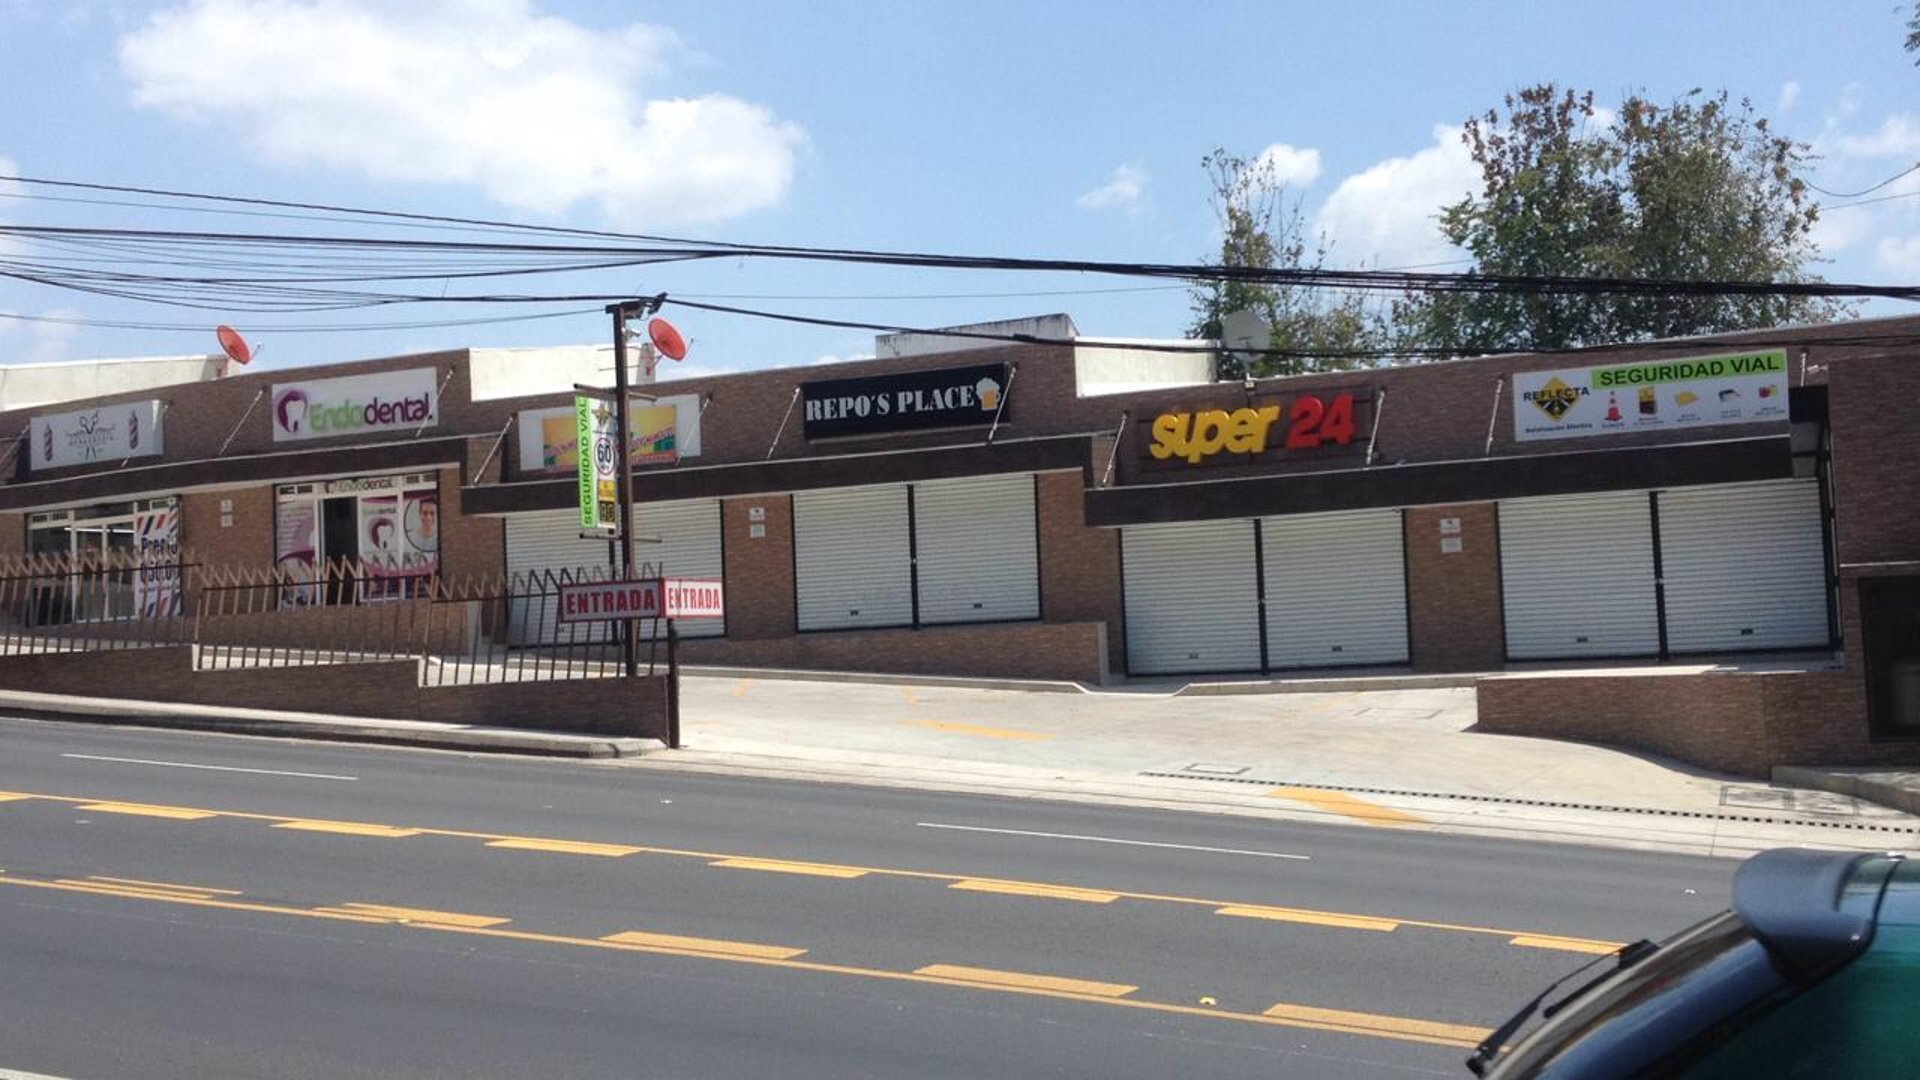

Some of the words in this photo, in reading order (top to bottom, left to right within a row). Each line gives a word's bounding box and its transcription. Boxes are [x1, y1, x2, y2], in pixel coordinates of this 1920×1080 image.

[1600, 361, 1724, 386] SEGURIDAD
[1730, 356, 1779, 373] VIAL
[310, 392, 432, 432] Endodental
[579, 395, 590, 432] VIAL
[897, 385, 974, 413] PLACE
[1150, 404, 1280, 464] super
[1287, 393, 1356, 449] 24
[581, 437, 593, 525] SEGURIDAD
[566, 589, 655, 615] ENTRADA
[668, 587, 721, 610] ENTRADA
